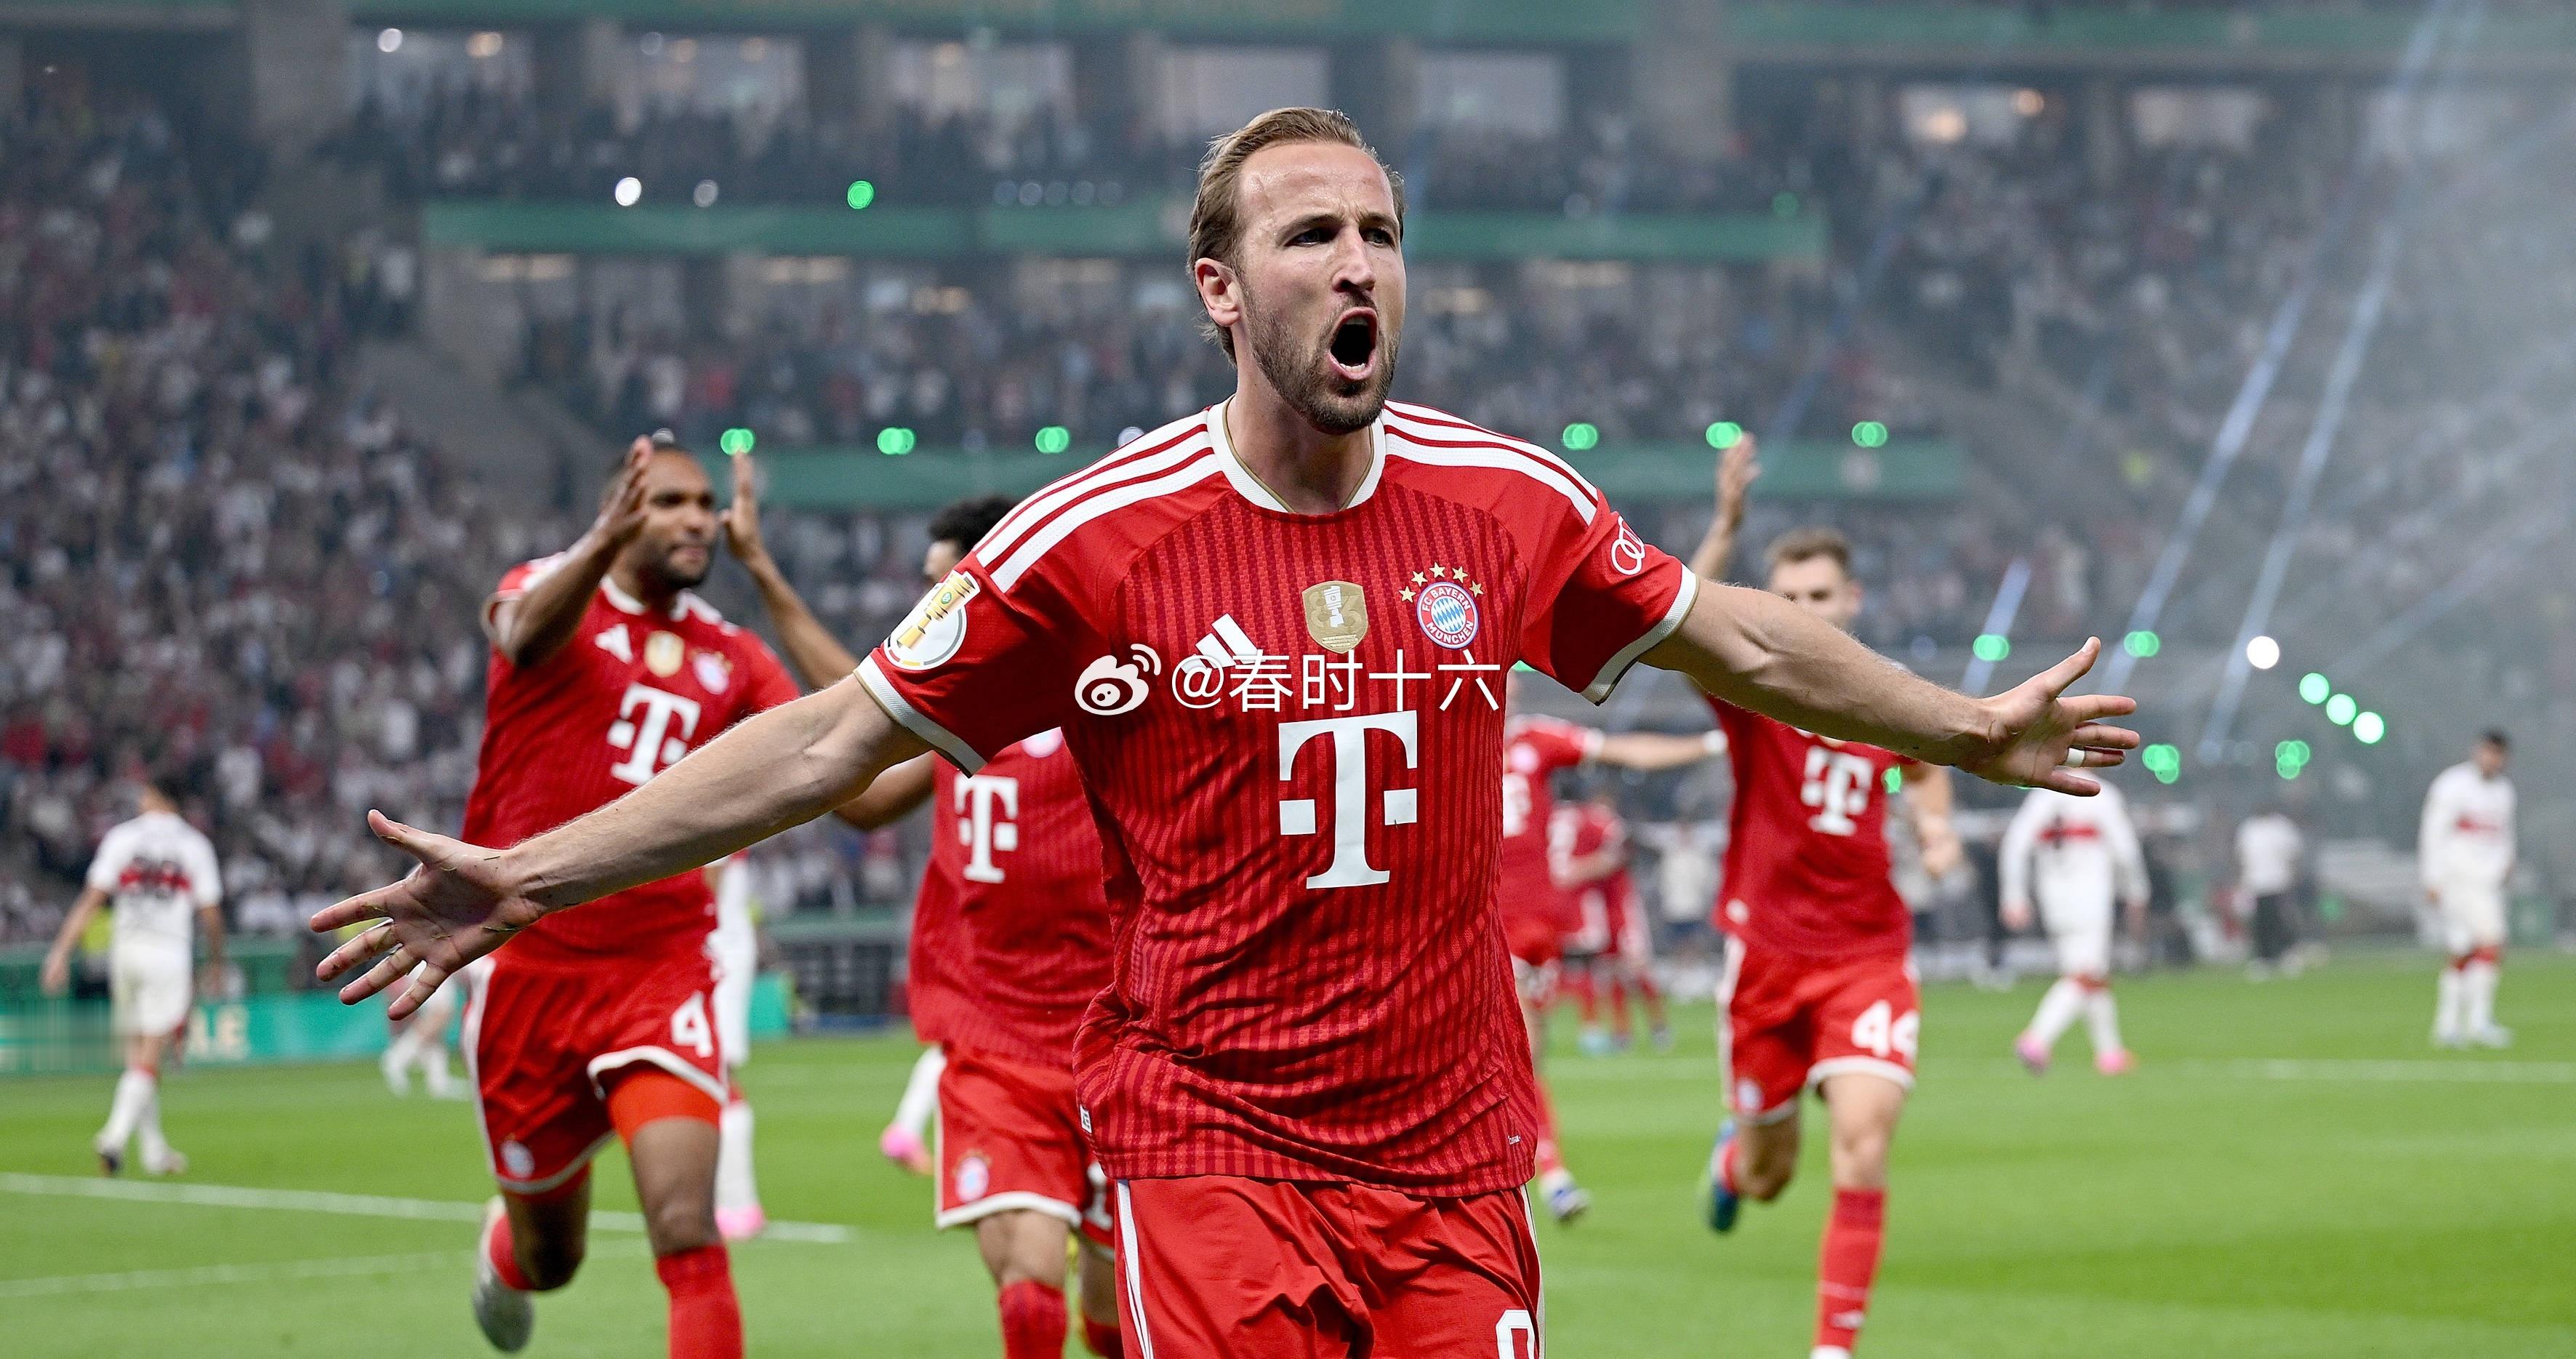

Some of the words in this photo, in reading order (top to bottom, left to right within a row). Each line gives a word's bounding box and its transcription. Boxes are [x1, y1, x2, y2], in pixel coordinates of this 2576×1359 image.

[1422, 596, 1433, 612] FC
[1430, 586, 1471, 610] BAYERN
[606, 681, 702, 786] T
[954, 773, 1019, 883] T
[1278, 710, 1417, 889] T
[1800, 745, 1874, 835] T
[670, 989, 713, 1058] 4
